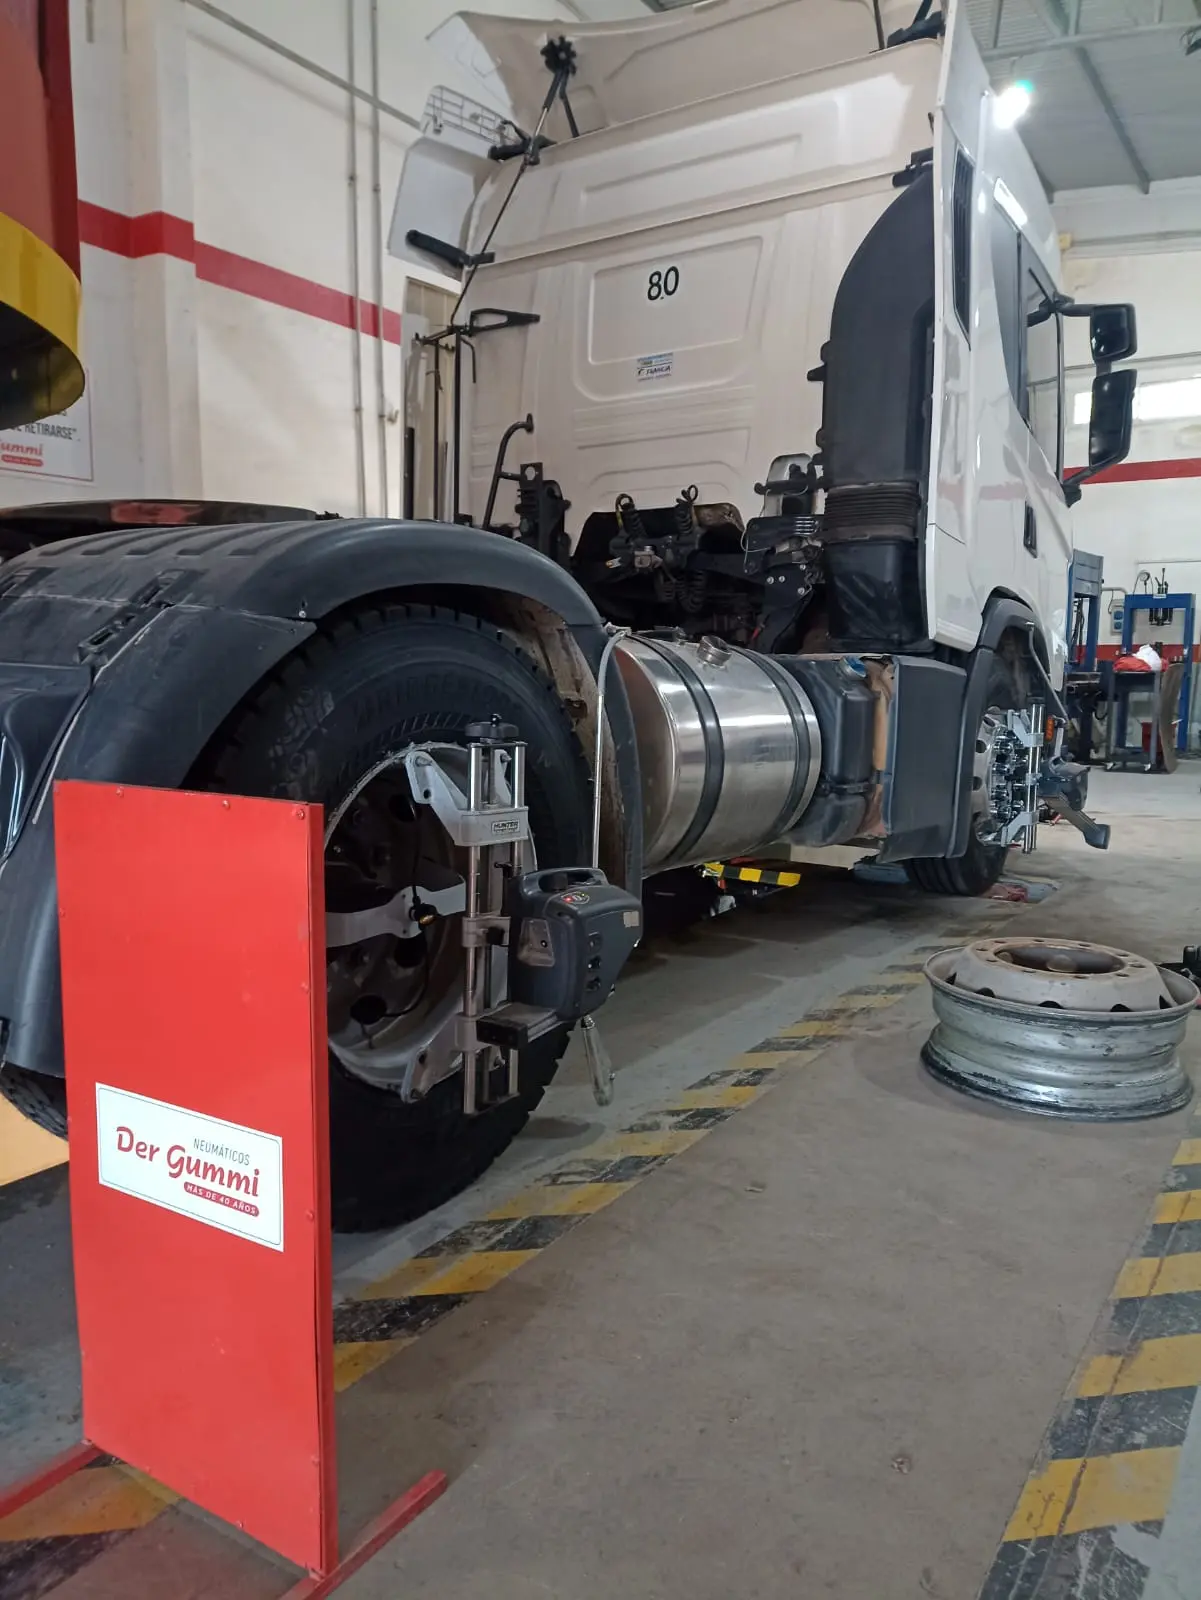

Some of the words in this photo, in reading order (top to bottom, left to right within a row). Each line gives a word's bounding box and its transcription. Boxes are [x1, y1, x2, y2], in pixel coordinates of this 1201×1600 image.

[0, 442, 43, 456] ummi
[116, 1126, 160, 1162] Der
[167, 1144, 260, 1197] Gummi
[193, 1138, 250, 1166] NEUMÁTICOS
[206, 1191, 217, 1200] DE
[220, 1196, 230, 1205] 40
[233, 1200, 256, 1214] AÑOS
